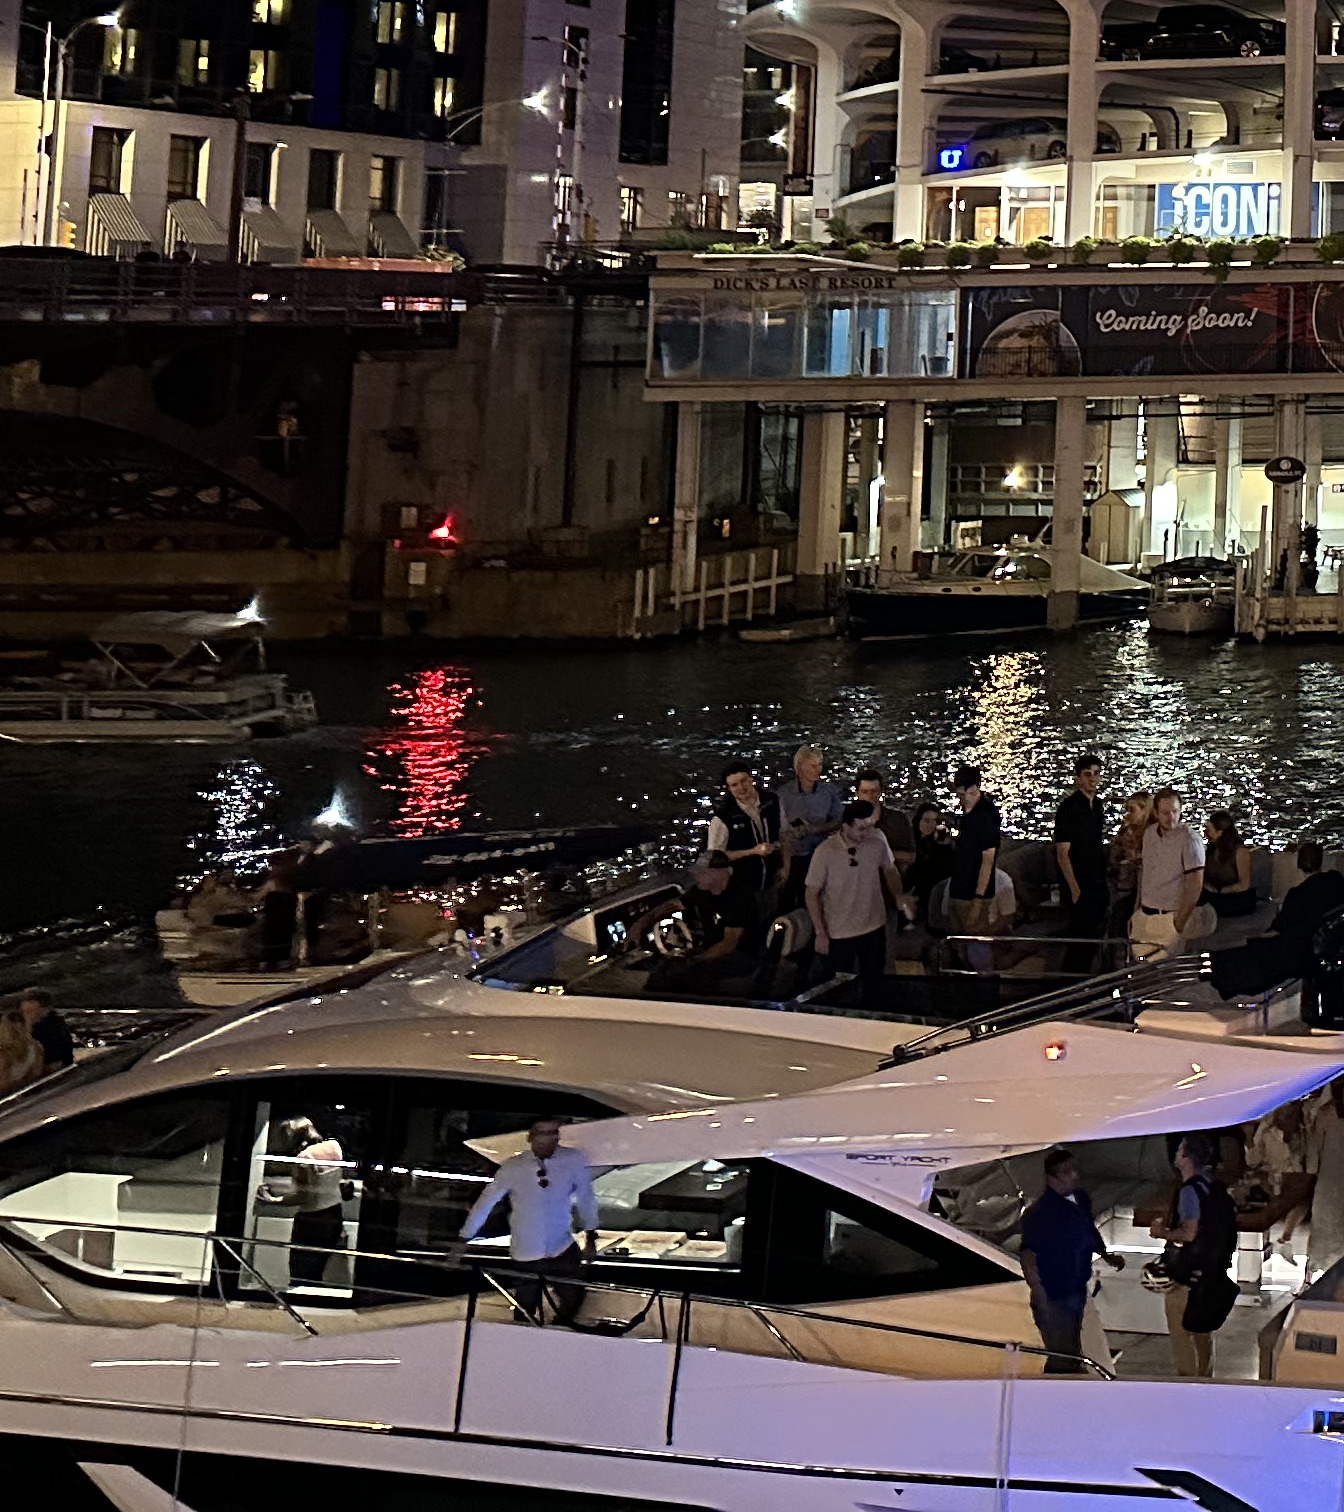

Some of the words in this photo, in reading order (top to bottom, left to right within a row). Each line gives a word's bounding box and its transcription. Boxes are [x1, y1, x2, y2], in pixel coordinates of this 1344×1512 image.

[713, 277, 770, 290] DICK'S
[828, 276, 897, 289] RESORT
[1095, 308, 1185, 337] Coming
[1186, 305, 1259, 335] Soon!
